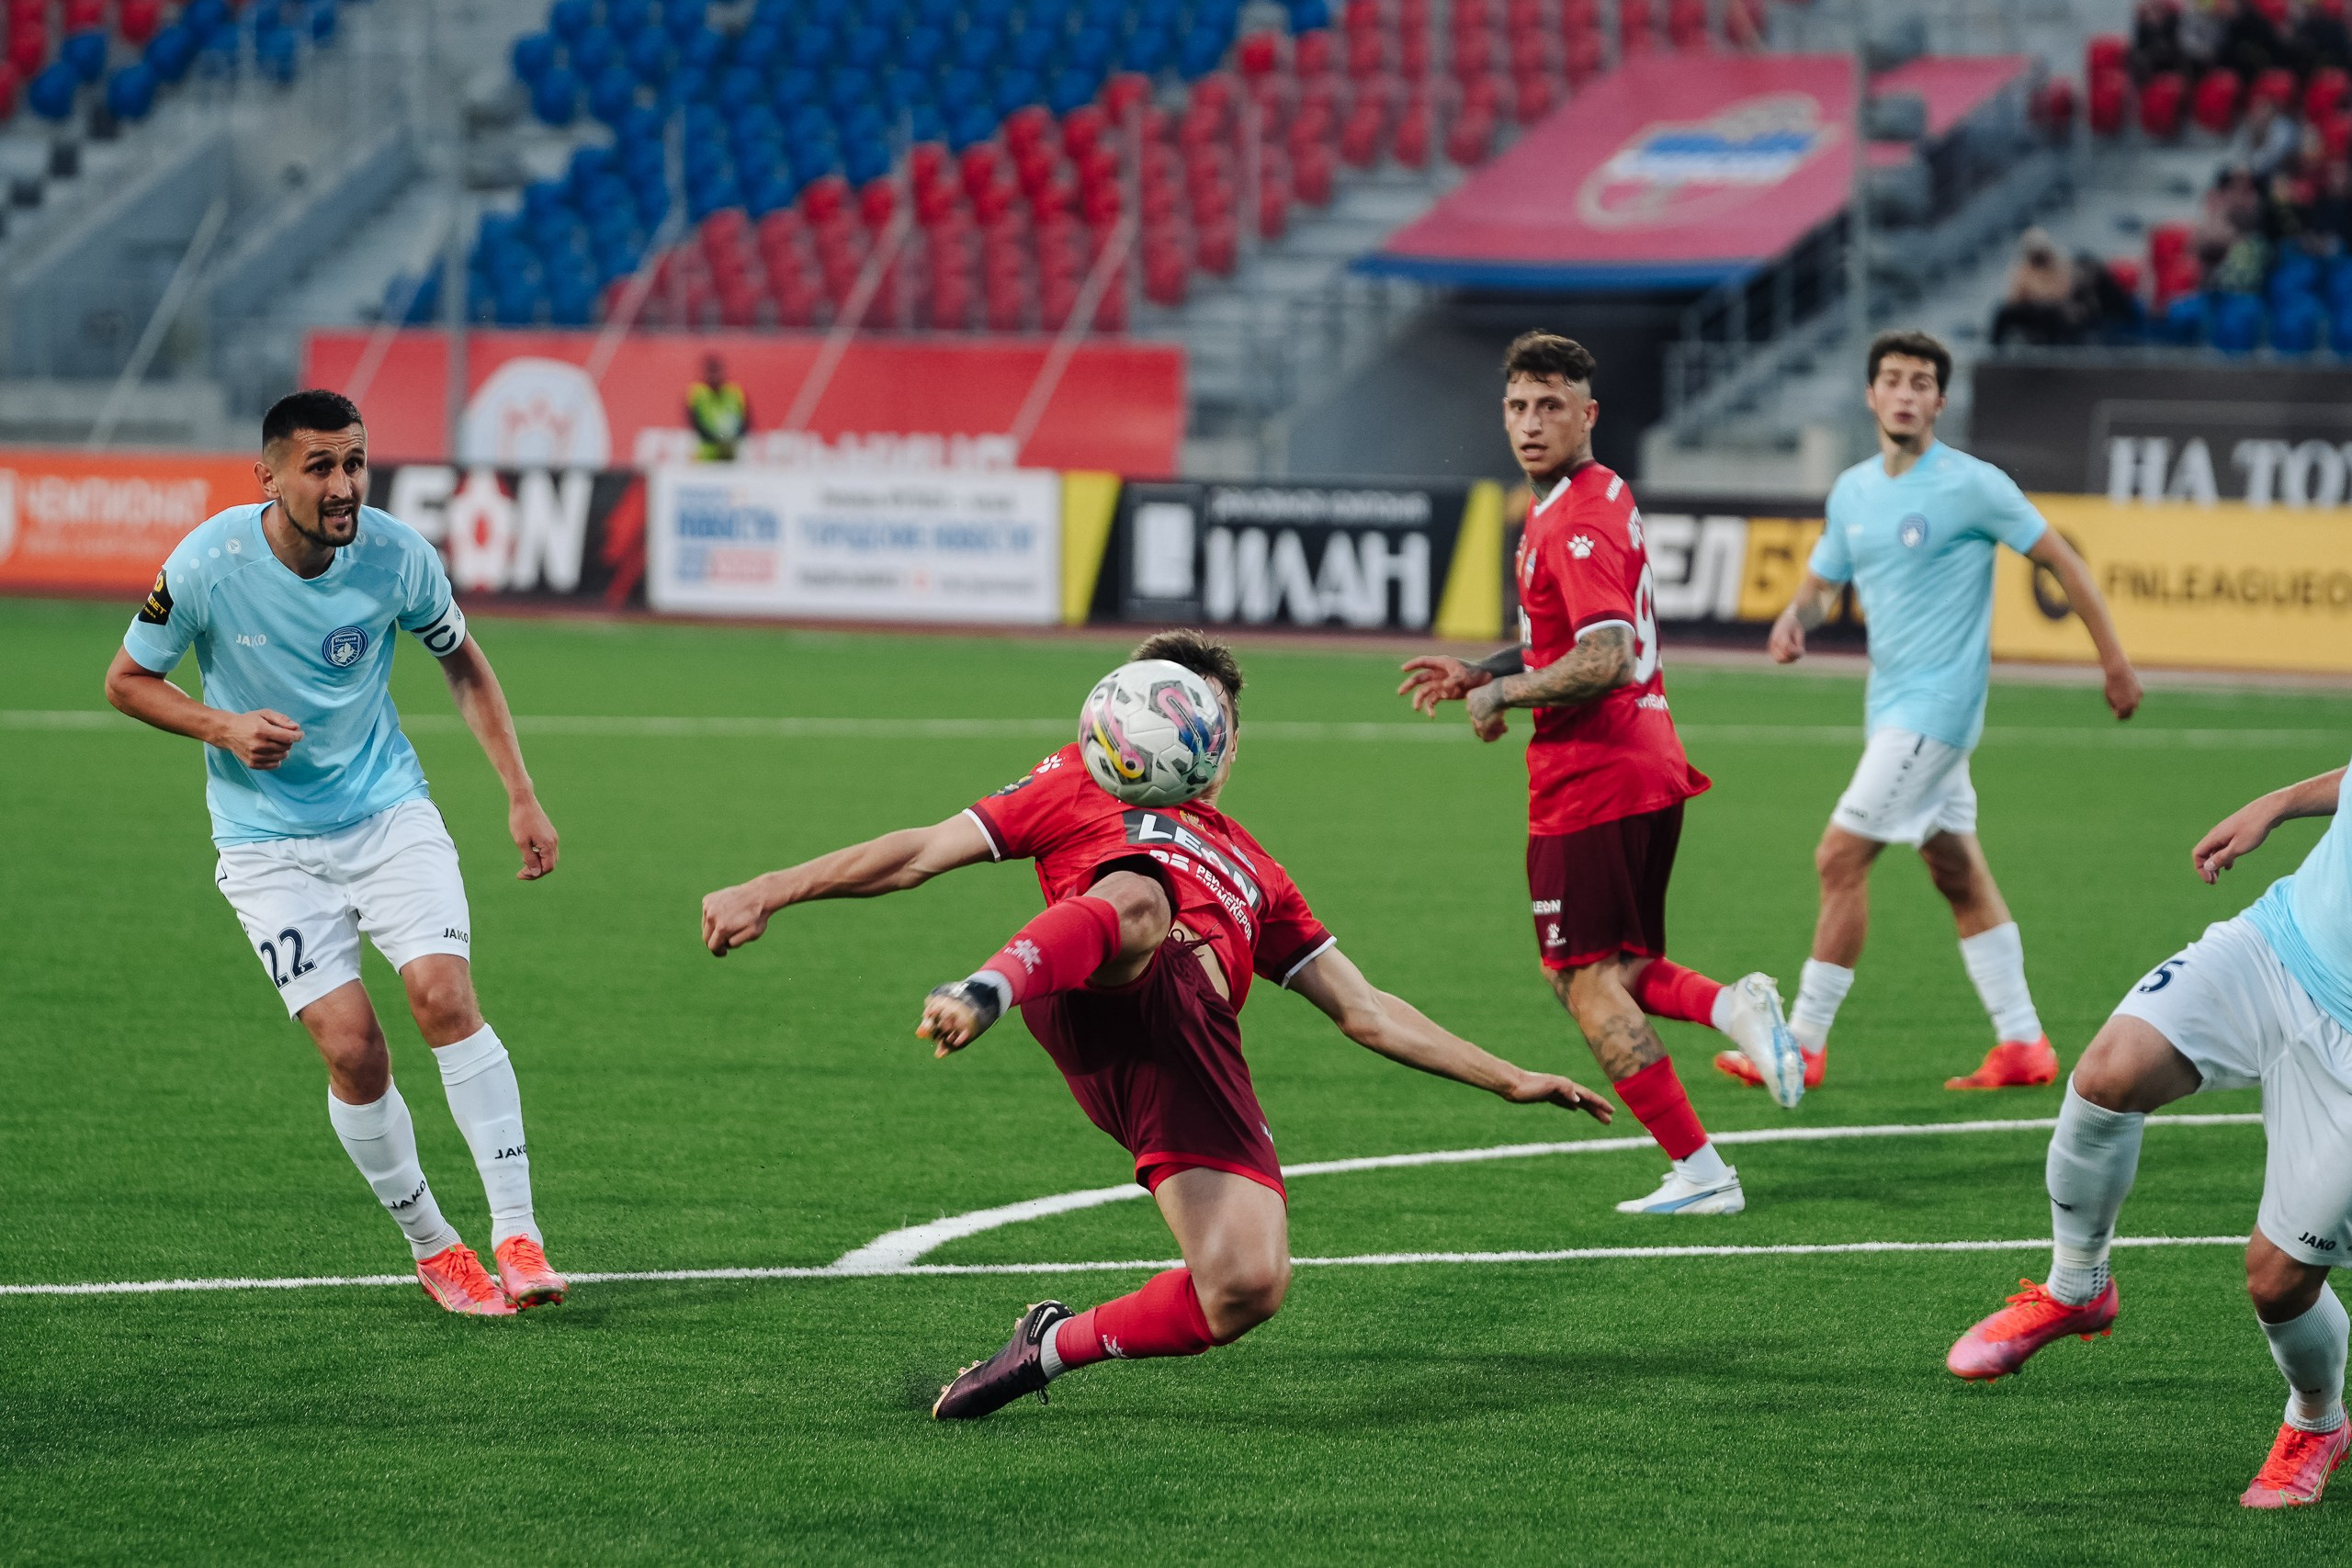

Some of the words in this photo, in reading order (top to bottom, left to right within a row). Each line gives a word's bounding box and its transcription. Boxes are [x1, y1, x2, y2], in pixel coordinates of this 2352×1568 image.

[2109, 435, 2220, 504] НА
[2233, 438, 2352, 508] ТО
[1204, 525, 1430, 629] ИЛАН
[236, 633, 267, 648] JAKO
[423, 624, 457, 653] C
[444, 928, 469, 943] JAKO
[259, 926, 318, 990] 22
[2137, 960, 2188, 994] 5
[390, 1179, 426, 1210] JAKO
[2298, 1232, 2336, 1251] JAKO
